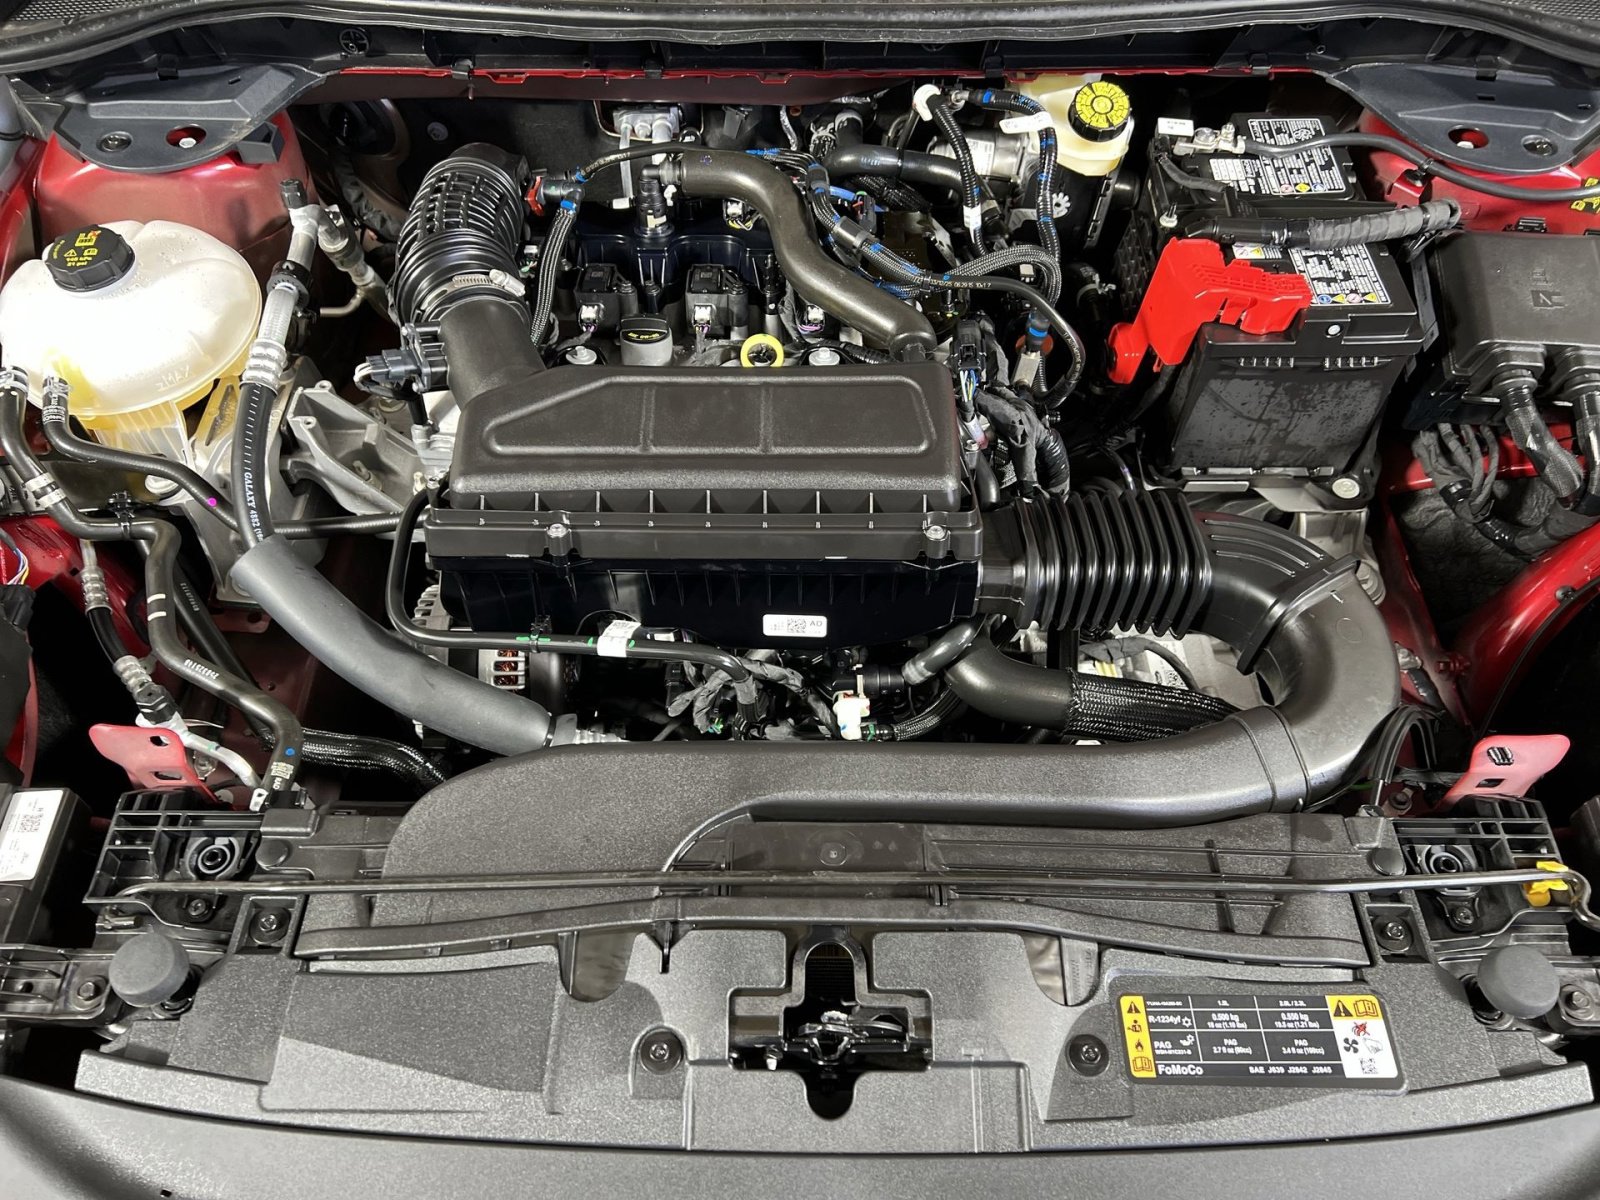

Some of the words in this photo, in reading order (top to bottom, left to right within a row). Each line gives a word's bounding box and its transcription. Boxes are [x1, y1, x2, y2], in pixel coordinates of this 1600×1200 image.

[244, 472, 256, 508] GALAXY
[1148, 1015, 1181, 1025] R-1234yf
[1154, 1041, 1172, 1049] PAG
[1224, 1038, 1238, 1046] PAG
[1157, 1064, 1204, 1075] FoMoCo
[1249, 1066, 1265, 1074] SAE
